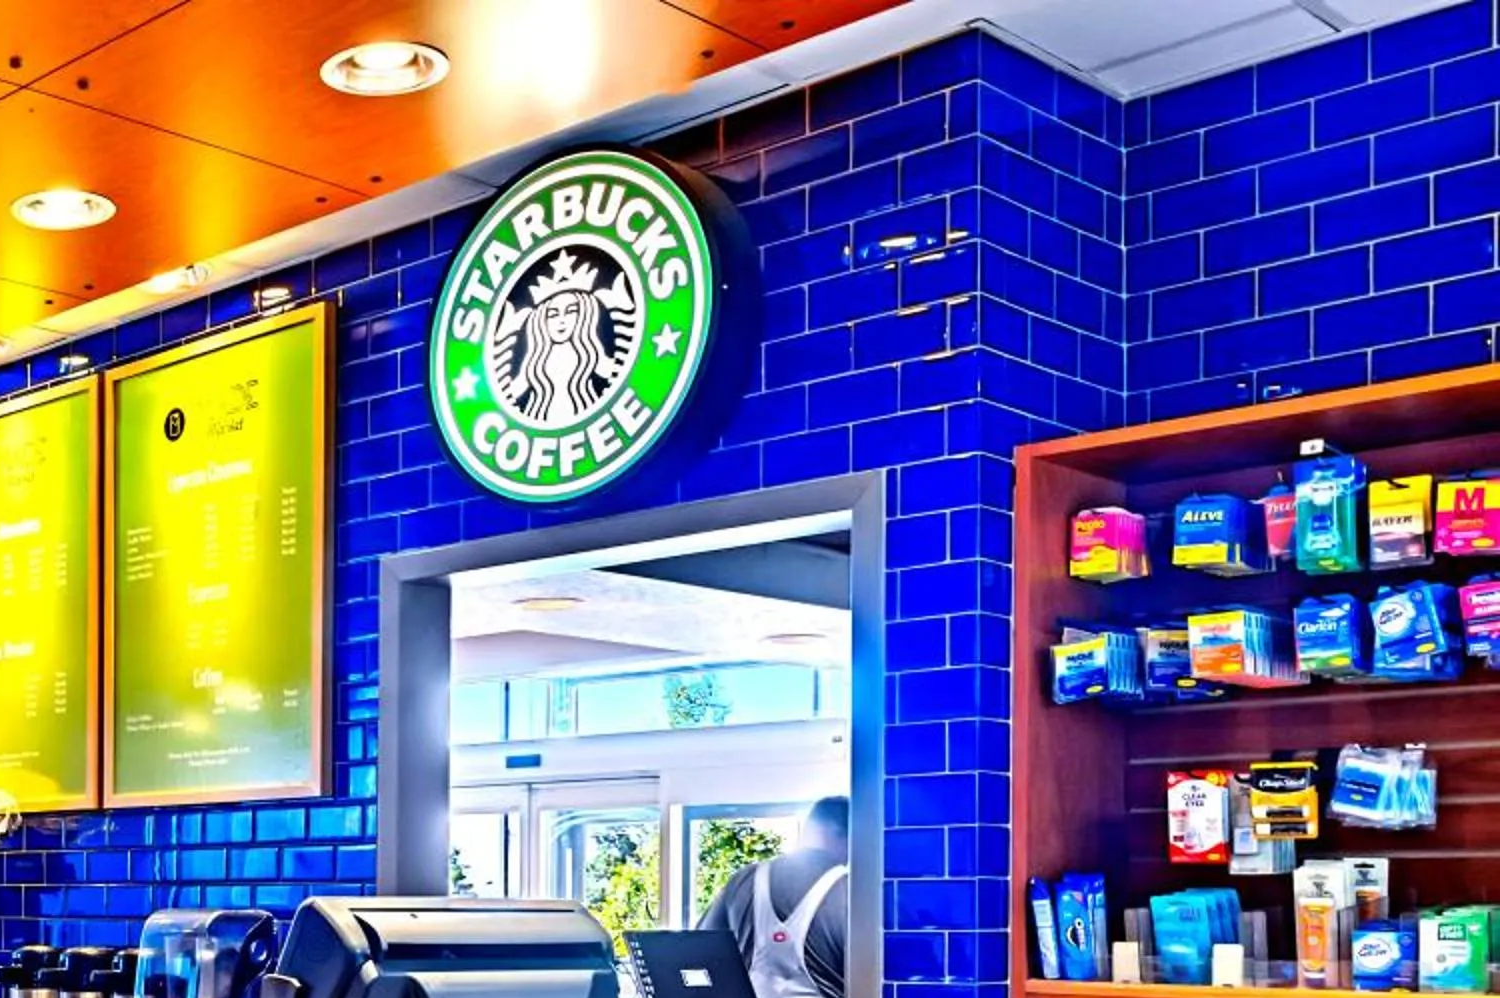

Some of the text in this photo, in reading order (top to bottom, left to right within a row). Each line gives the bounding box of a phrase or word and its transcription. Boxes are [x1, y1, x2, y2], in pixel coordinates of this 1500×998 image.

[453, 182, 688, 343] STARBUCKS
[473, 389, 652, 479] COFFEE
[1181, 509, 1225, 523] ALEVE
[1298, 618, 1337, 634] Claritin
[1181, 792, 1207, 800] CLEAR
